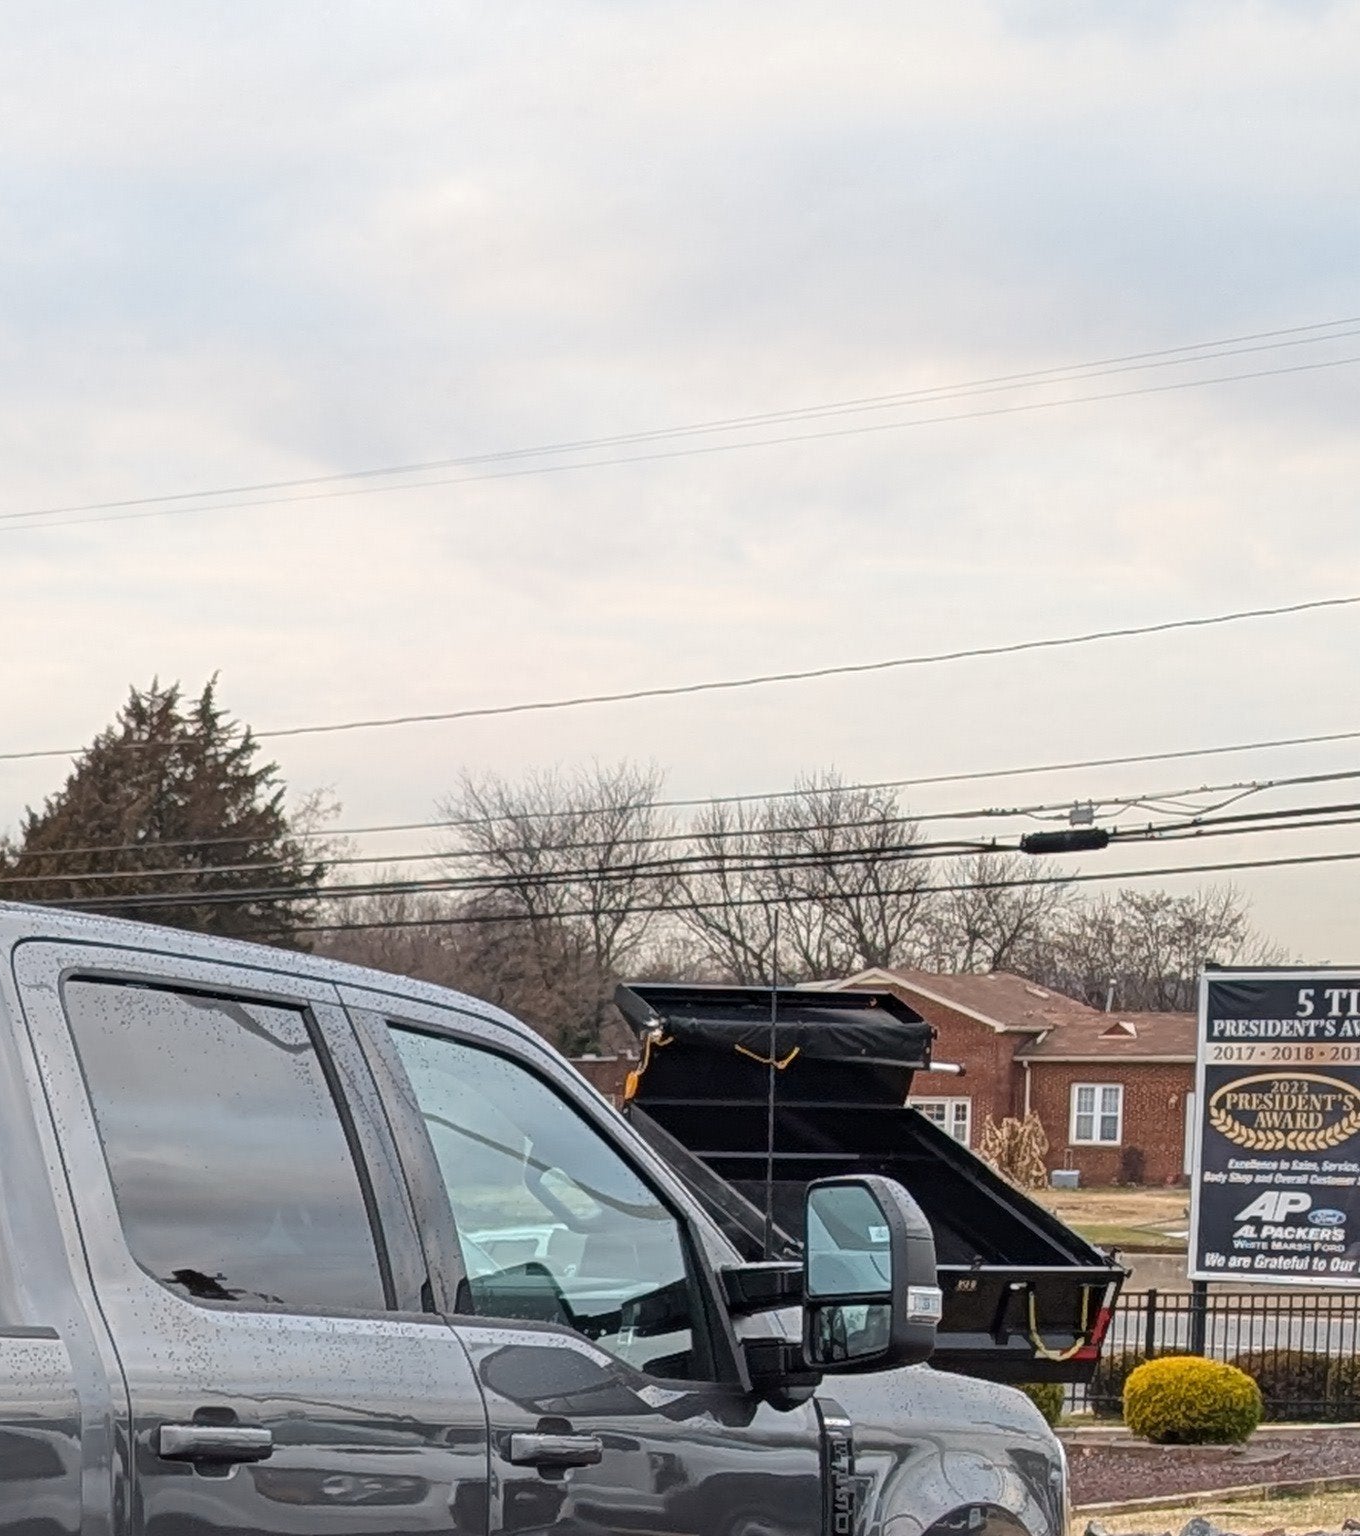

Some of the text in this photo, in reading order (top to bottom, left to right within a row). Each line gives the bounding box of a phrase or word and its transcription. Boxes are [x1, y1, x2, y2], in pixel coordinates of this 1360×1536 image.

[1295, 988, 1315, 1018] 5
[1212, 1019, 1336, 1038] PRESIDENT'S
[1213, 1046, 1256, 1061] 2017
[1271, 1046, 1314, 1061] 2018
[1270, 1081, 1309, 1093] 2023
[1225, 1093, 1355, 1111] PRESIDENT'S
[1254, 1111, 1323, 1129] AWARD
[1234, 1191, 1312, 1222] AP
[1233, 1225, 1258, 1238] AL
[1205, 1252, 1357, 1272] We are Grateful to Our
